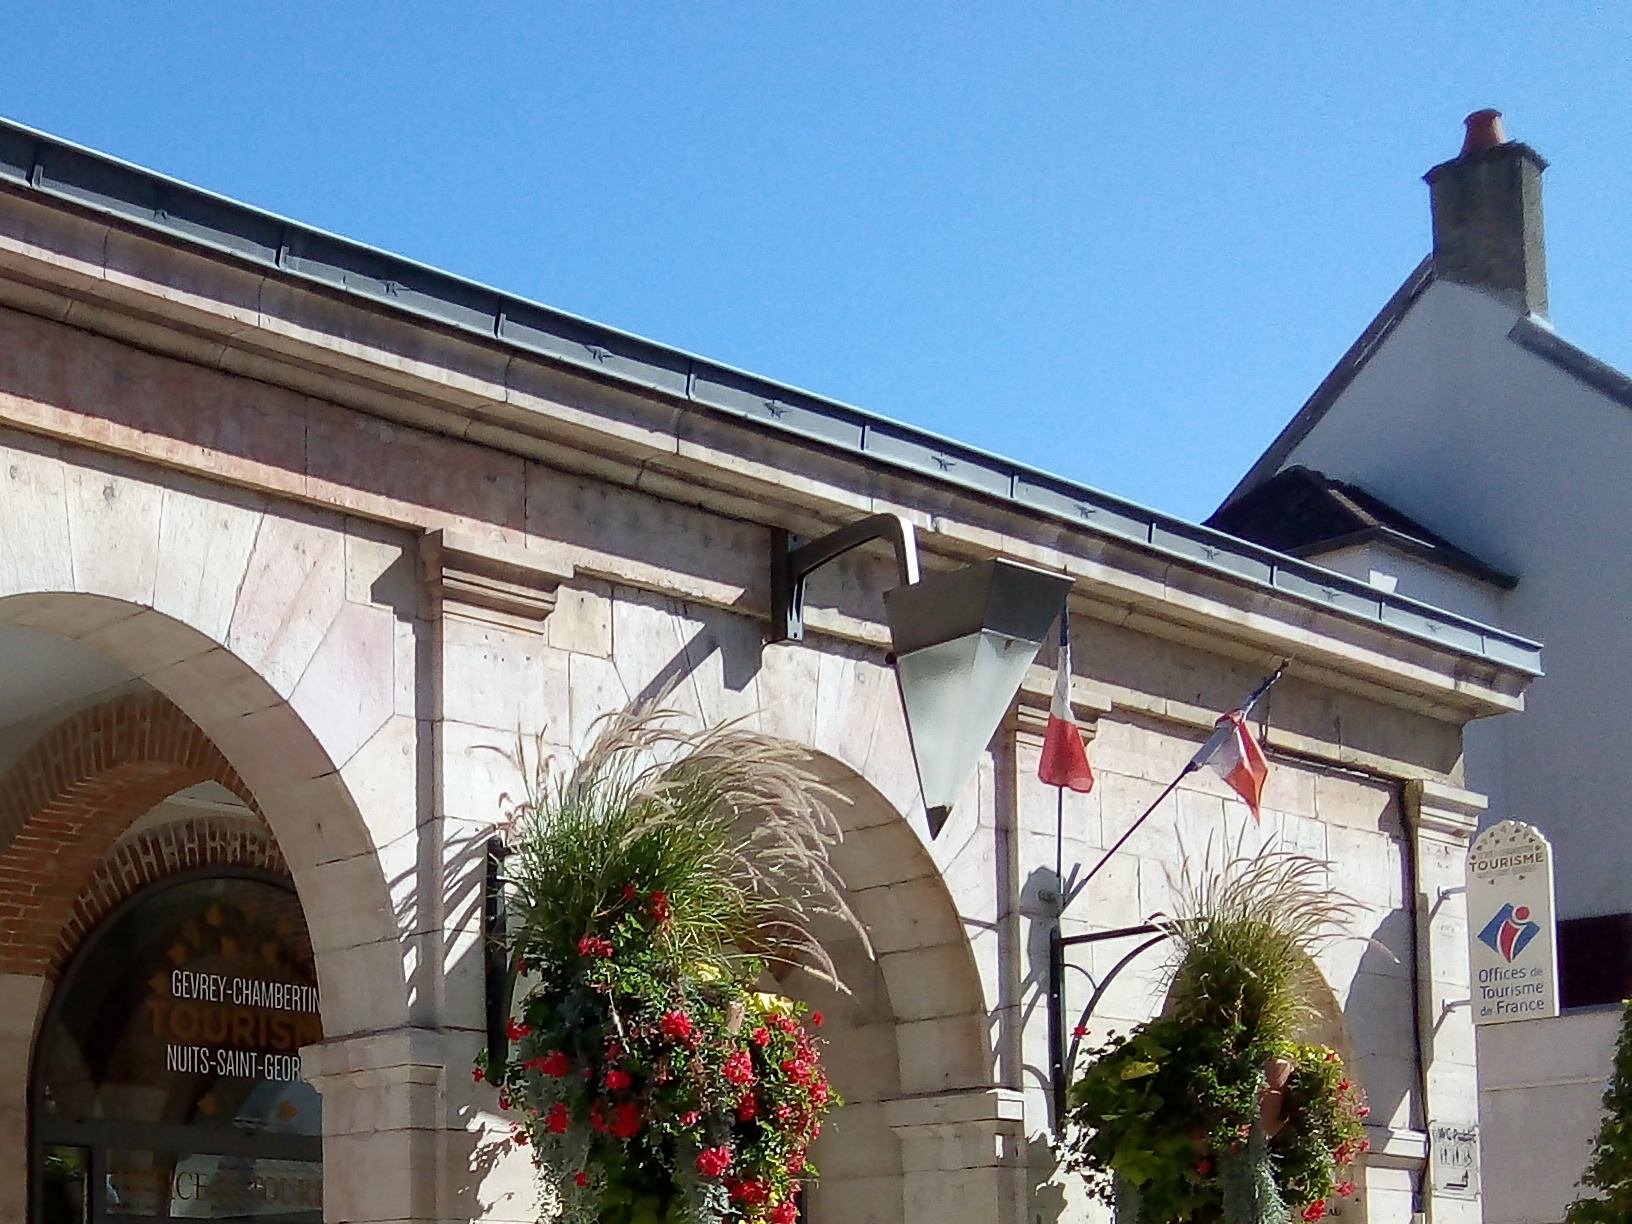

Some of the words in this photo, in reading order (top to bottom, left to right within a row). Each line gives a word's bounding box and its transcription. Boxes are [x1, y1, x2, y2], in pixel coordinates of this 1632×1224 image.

[1468, 852, 1544, 872] TOURISME
[1478, 966, 1527, 983] Offices
[171, 969, 321, 1013] GEVREY-CHAMBERTIN
[1479, 982, 1544, 999] Tourisme
[1496, 999, 1545, 1014] France
